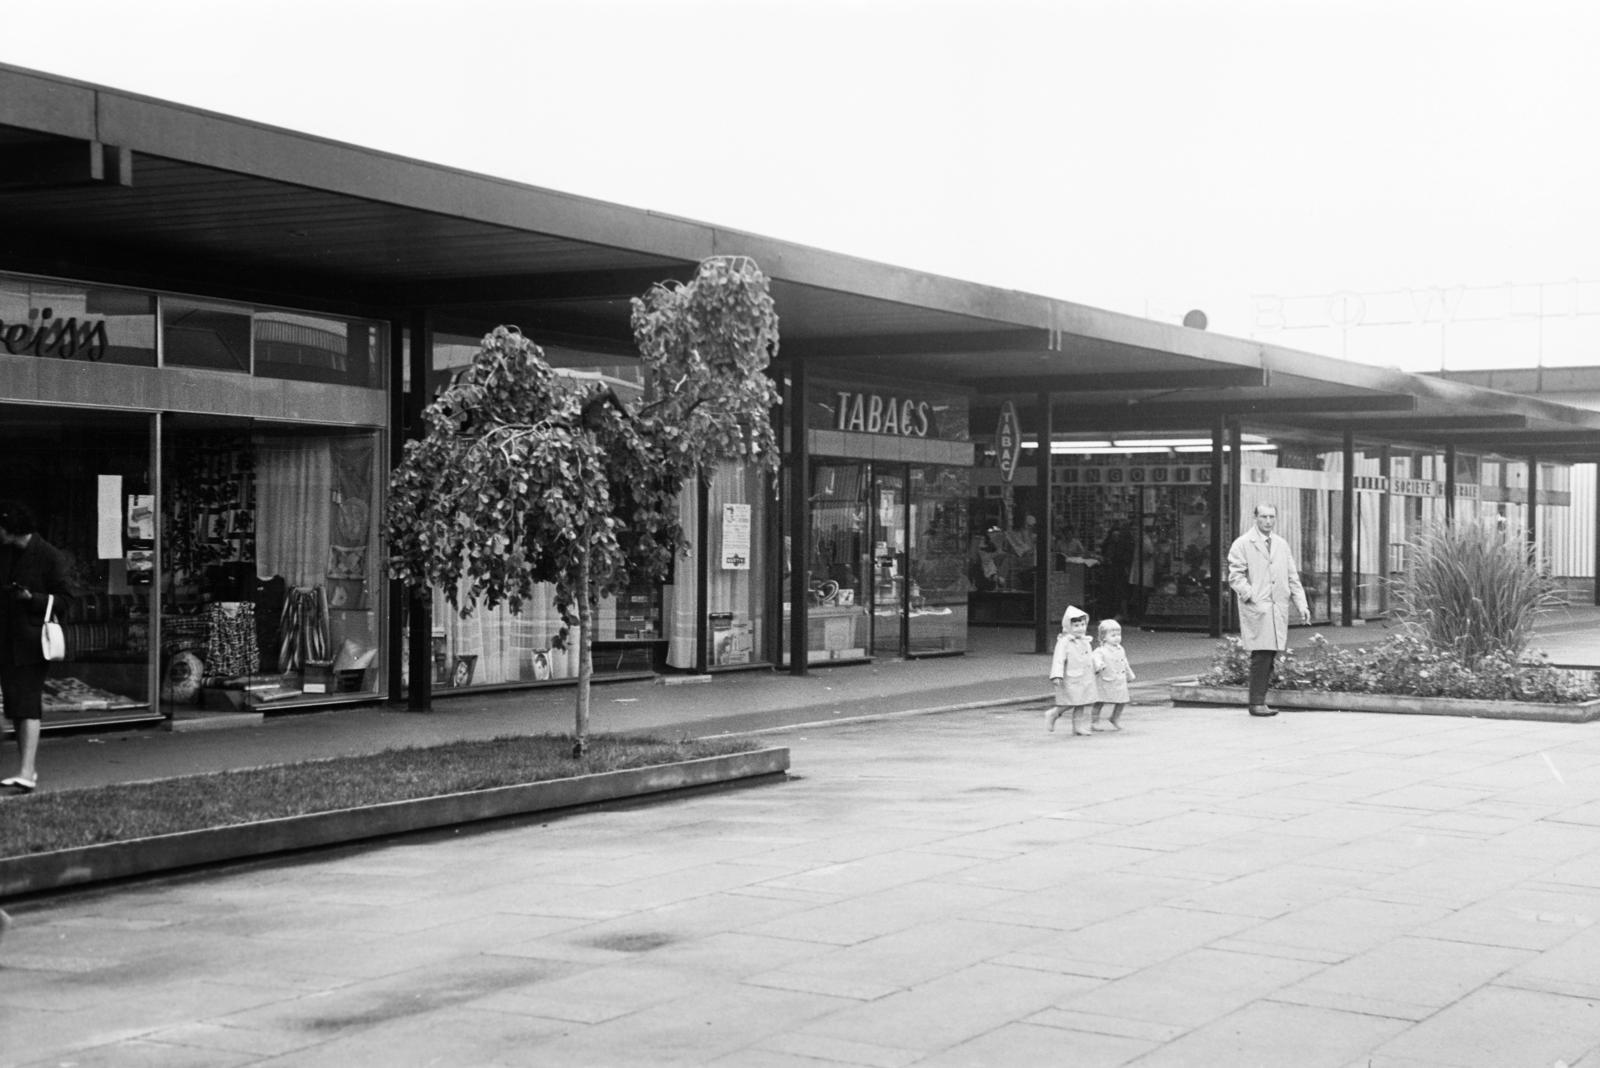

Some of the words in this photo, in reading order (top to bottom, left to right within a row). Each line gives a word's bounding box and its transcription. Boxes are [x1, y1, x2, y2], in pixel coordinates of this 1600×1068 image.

[0, 307, 109, 361] eiss
[837, 391, 929, 437] TABACS
[1001, 411, 1012, 471] TABAC
